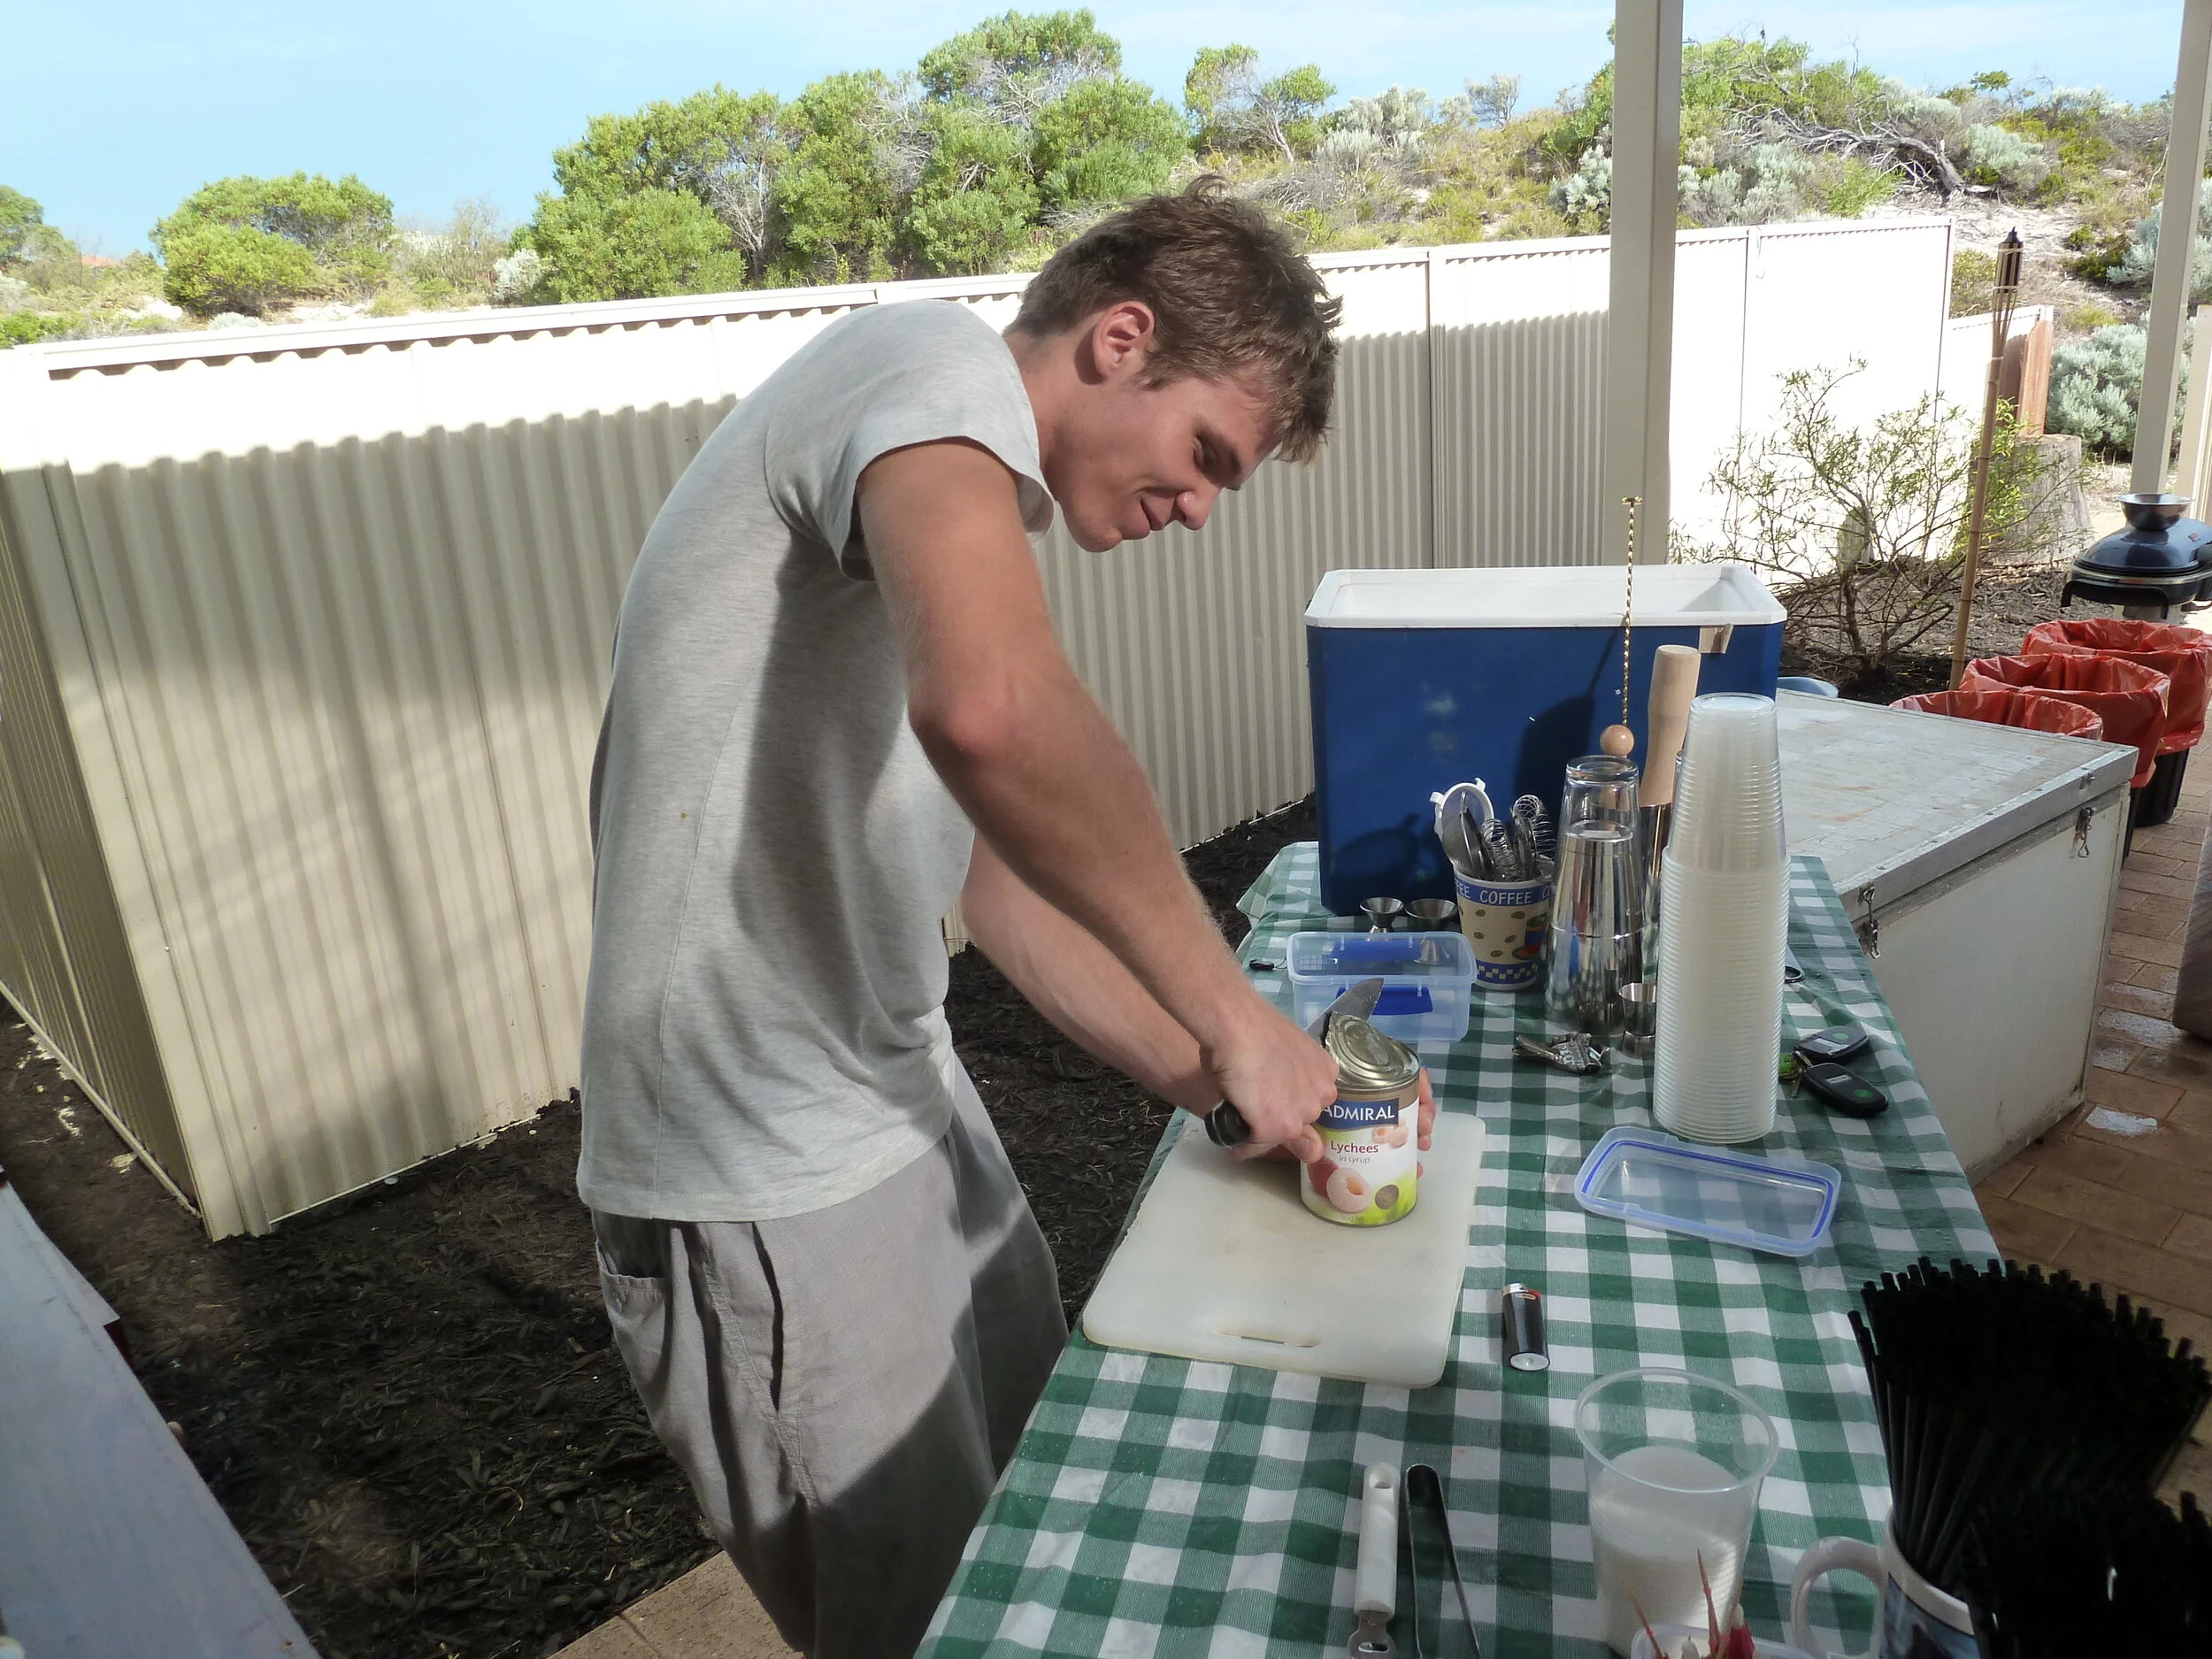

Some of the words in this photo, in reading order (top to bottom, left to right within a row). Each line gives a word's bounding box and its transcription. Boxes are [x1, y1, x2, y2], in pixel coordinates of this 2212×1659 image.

[1479, 890, 1532, 905] COFFEE
[1324, 1104, 1395, 1121] ADMIRAL
[1331, 1141, 1379, 1154] Lychees
[1348, 1156, 1371, 1165] syrup
